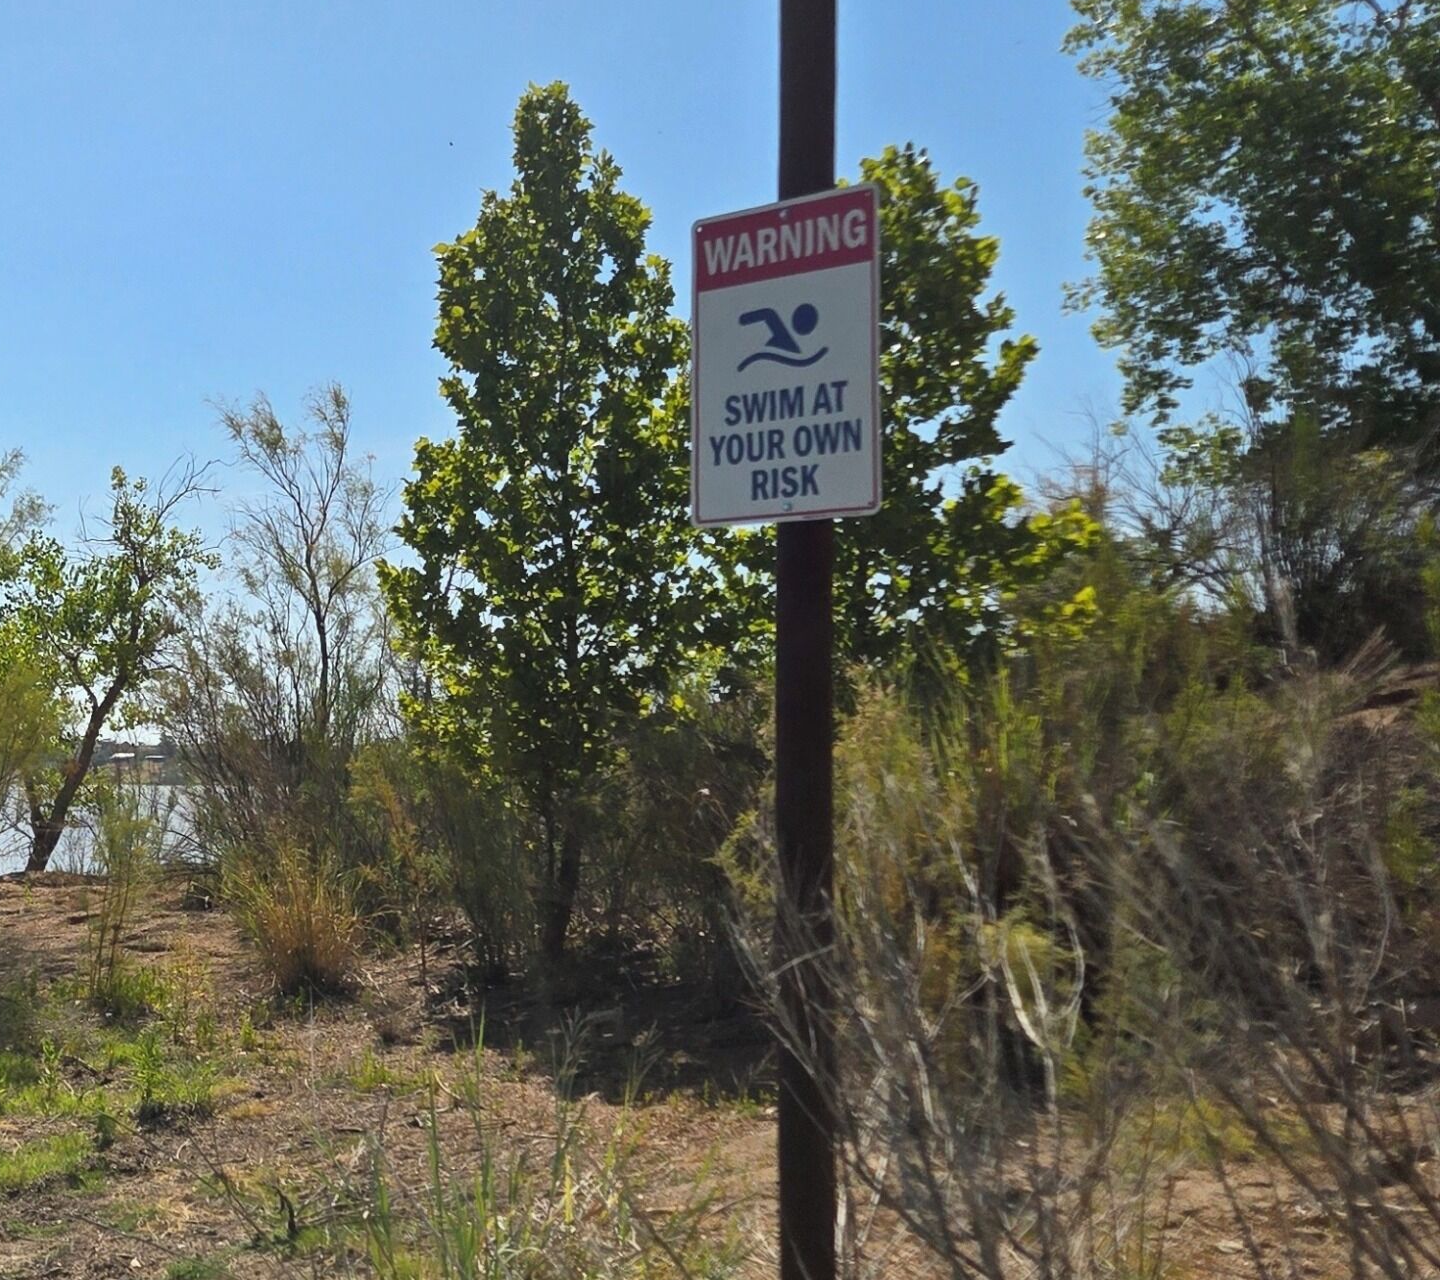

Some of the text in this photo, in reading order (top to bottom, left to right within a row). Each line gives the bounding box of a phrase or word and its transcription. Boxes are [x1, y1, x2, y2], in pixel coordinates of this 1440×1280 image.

[703, 208, 867, 276] WARNING
[724, 380, 848, 426] SWIM AT
[710, 418, 863, 466] YOUR OWN
[751, 464, 820, 501] RISK
